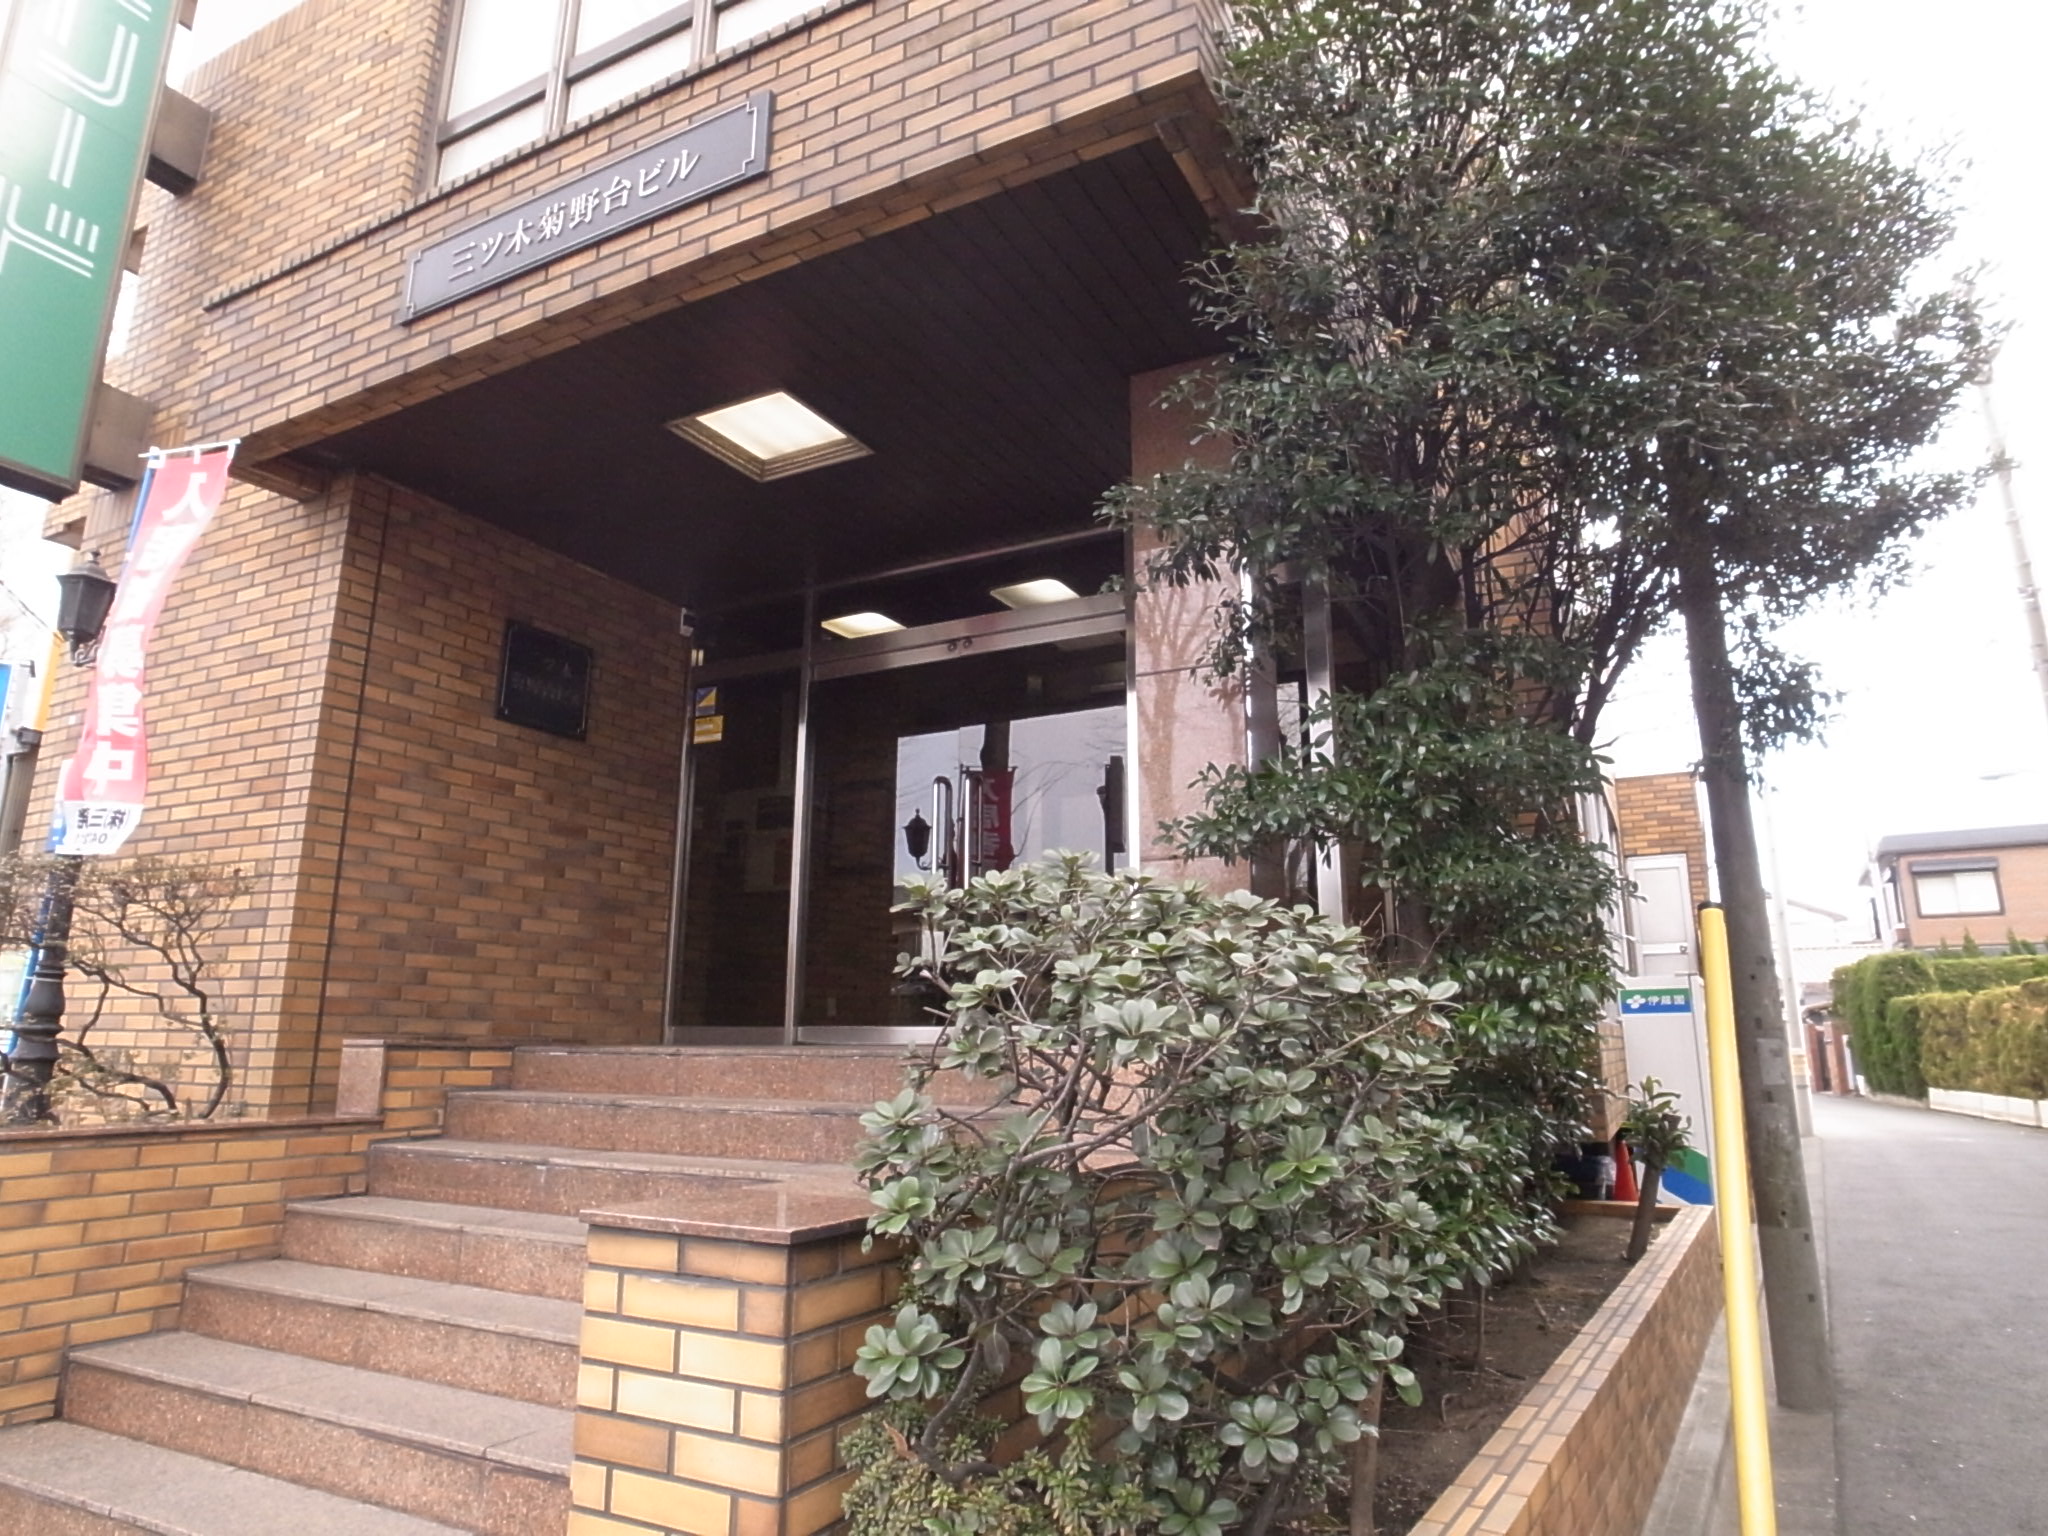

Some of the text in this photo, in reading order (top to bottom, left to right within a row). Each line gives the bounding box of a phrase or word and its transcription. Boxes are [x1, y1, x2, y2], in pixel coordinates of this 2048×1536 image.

[448, 148, 701, 282] 三ツ木菊野台ビル
